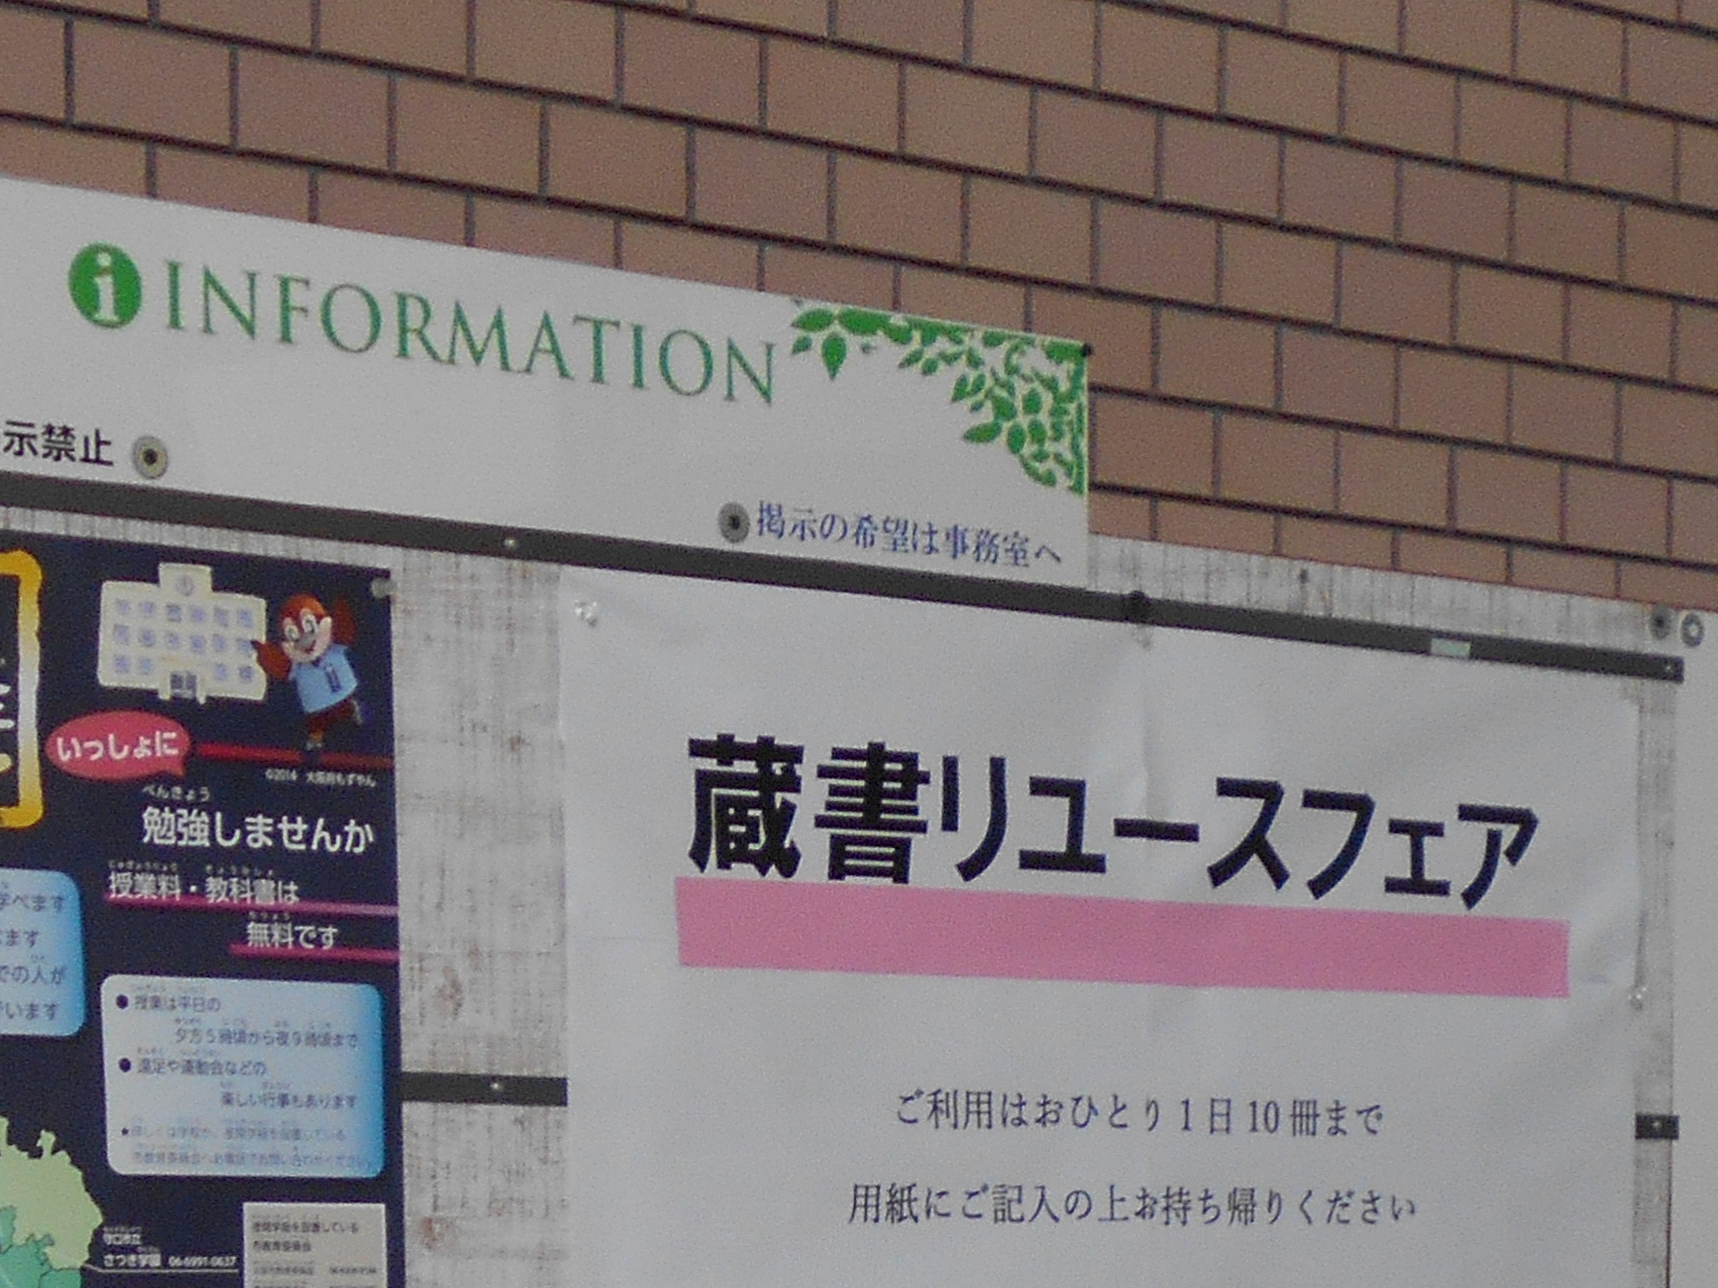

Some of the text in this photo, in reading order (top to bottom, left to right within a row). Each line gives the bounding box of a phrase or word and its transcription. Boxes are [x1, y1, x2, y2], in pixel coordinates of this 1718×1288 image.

[165, 258, 778, 406] INFORMATION
[755, 500, 1063, 568] 掲示の希望は事務室へ
[55, 728, 181, 764] いっしょに
[142, 785, 212, 802] べんきょう
[142, 805, 375, 854] 勉強しませんか
[686, 731, 1540, 911] 蔵書リユースフェア
[109, 871, 301, 905] 授業料・教科書は
[246, 921, 339, 950] 無料です
[847, 1181, 1418, 1229] 用紙にご記入の上お持ち帰りください
